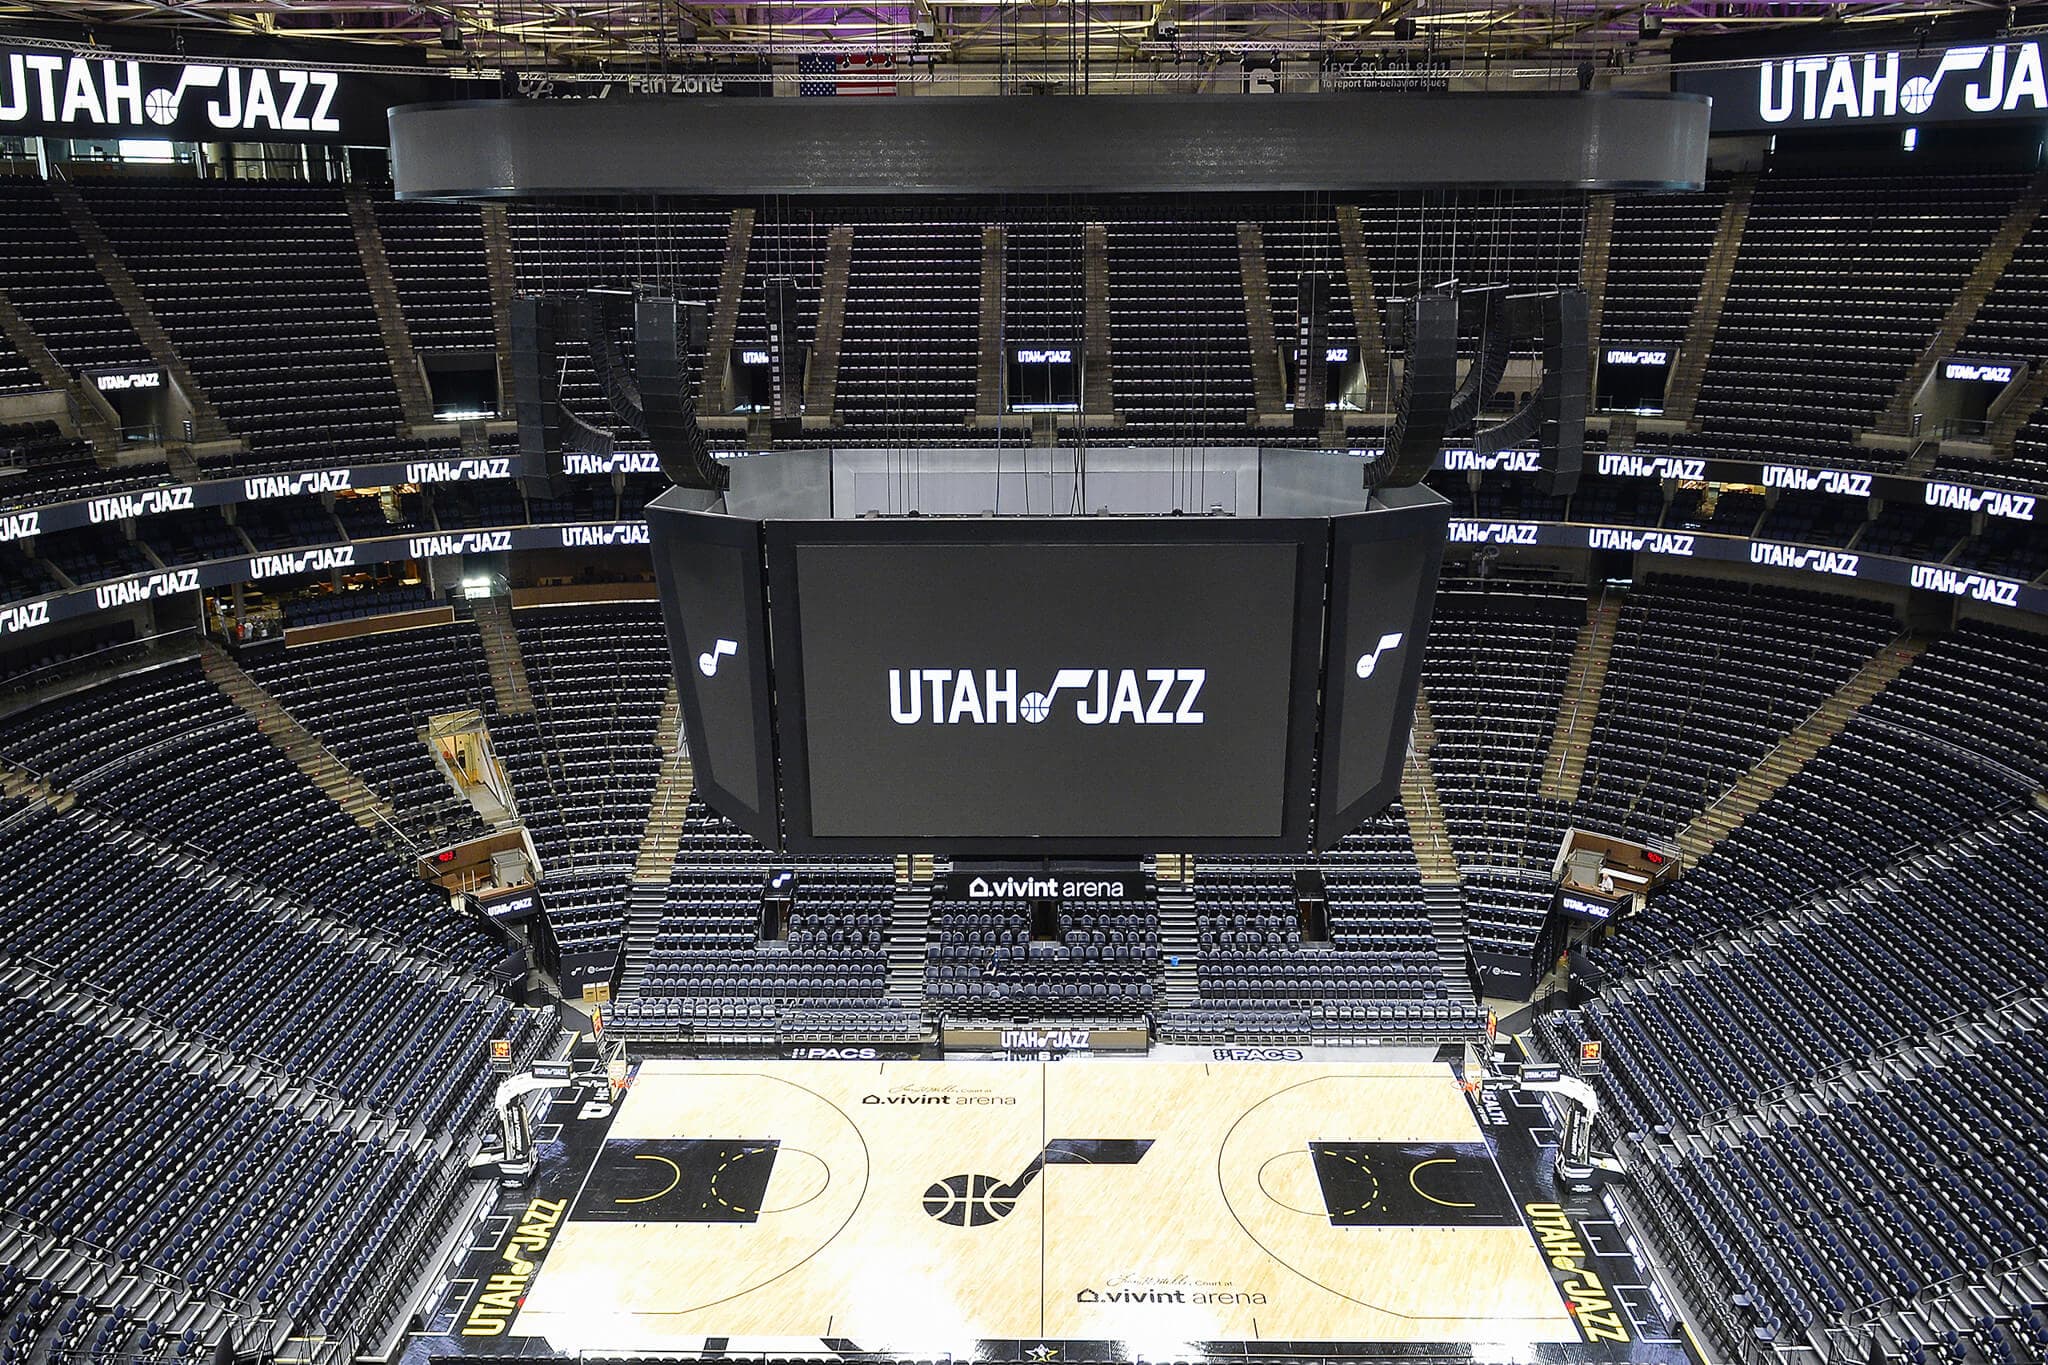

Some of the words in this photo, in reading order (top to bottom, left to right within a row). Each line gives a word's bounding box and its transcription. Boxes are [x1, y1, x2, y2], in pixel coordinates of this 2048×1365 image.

[1322, 80, 1332, 88] To
[1334, 80, 1361, 89] report
[1760, 52, 1899, 122] UTAH
[1965, 42, 2048, 112] JA
[207, 66, 340, 131] JAZZ
[406, 462, 450, 484] UTAH
[467, 458, 511, 479] JAZZ
[619, 453, 661, 473] JAZZ
[1599, 454, 1643, 478] UTAH
[1660, 458, 1706, 481] JAZZ
[245, 475, 292, 501] UTAH
[307, 469, 351, 495] JAZZ
[1762, 464, 1808, 489] UTAH
[1825, 470, 1873, 497] JAZZ
[88, 496, 134, 524] UTAH
[149, 487, 194, 513] JAZZ
[1925, 482, 1971, 511] UTAH
[1987, 491, 2036, 520] JAZZ
[409, 535, 453, 558] UTAH
[470, 530, 513, 552] JAZZ
[562, 525, 603, 546] UTAH
[620, 525, 651, 544] JAZ
[1446, 523, 1478, 542] TAH
[1495, 524, 1538, 545] JAZZ
[1589, 528, 1632, 550] UTAH
[1650, 533, 1694, 556] JAZZ
[251, 552, 295, 579] UTAH
[311, 545, 355, 570] JAZZ
[1750, 542, 1796, 568] UTAH
[1812, 550, 1859, 577] JAZZ
[96, 579, 141, 609] UTAH
[157, 568, 201, 597] JAZZ
[1911, 565, 1958, 594] UTAH
[1972, 575, 2019, 607] JAZZ
[7, 601, 50, 632] JAZZ
[889, 669, 1017, 725] UTAH
[1076, 668, 1206, 725] JAZZ
[1062, 881, 1124, 897] arena
[808, 1048, 876, 1059] PACS
[1001, 1031, 1038, 1048] UTAH
[1052, 1031, 1090, 1048] JAZZ
[1231, 1049, 1302, 1060] PACS
[956, 1096, 1017, 1105] arena
[461, 1274, 529, 1336] UTAH
[511, 1198, 568, 1251] JAZZ
[1525, 1202, 1586, 1257] UTAH
[1563, 1279, 1631, 1343] JAZZ
[1192, 1292, 1268, 1304] arena
